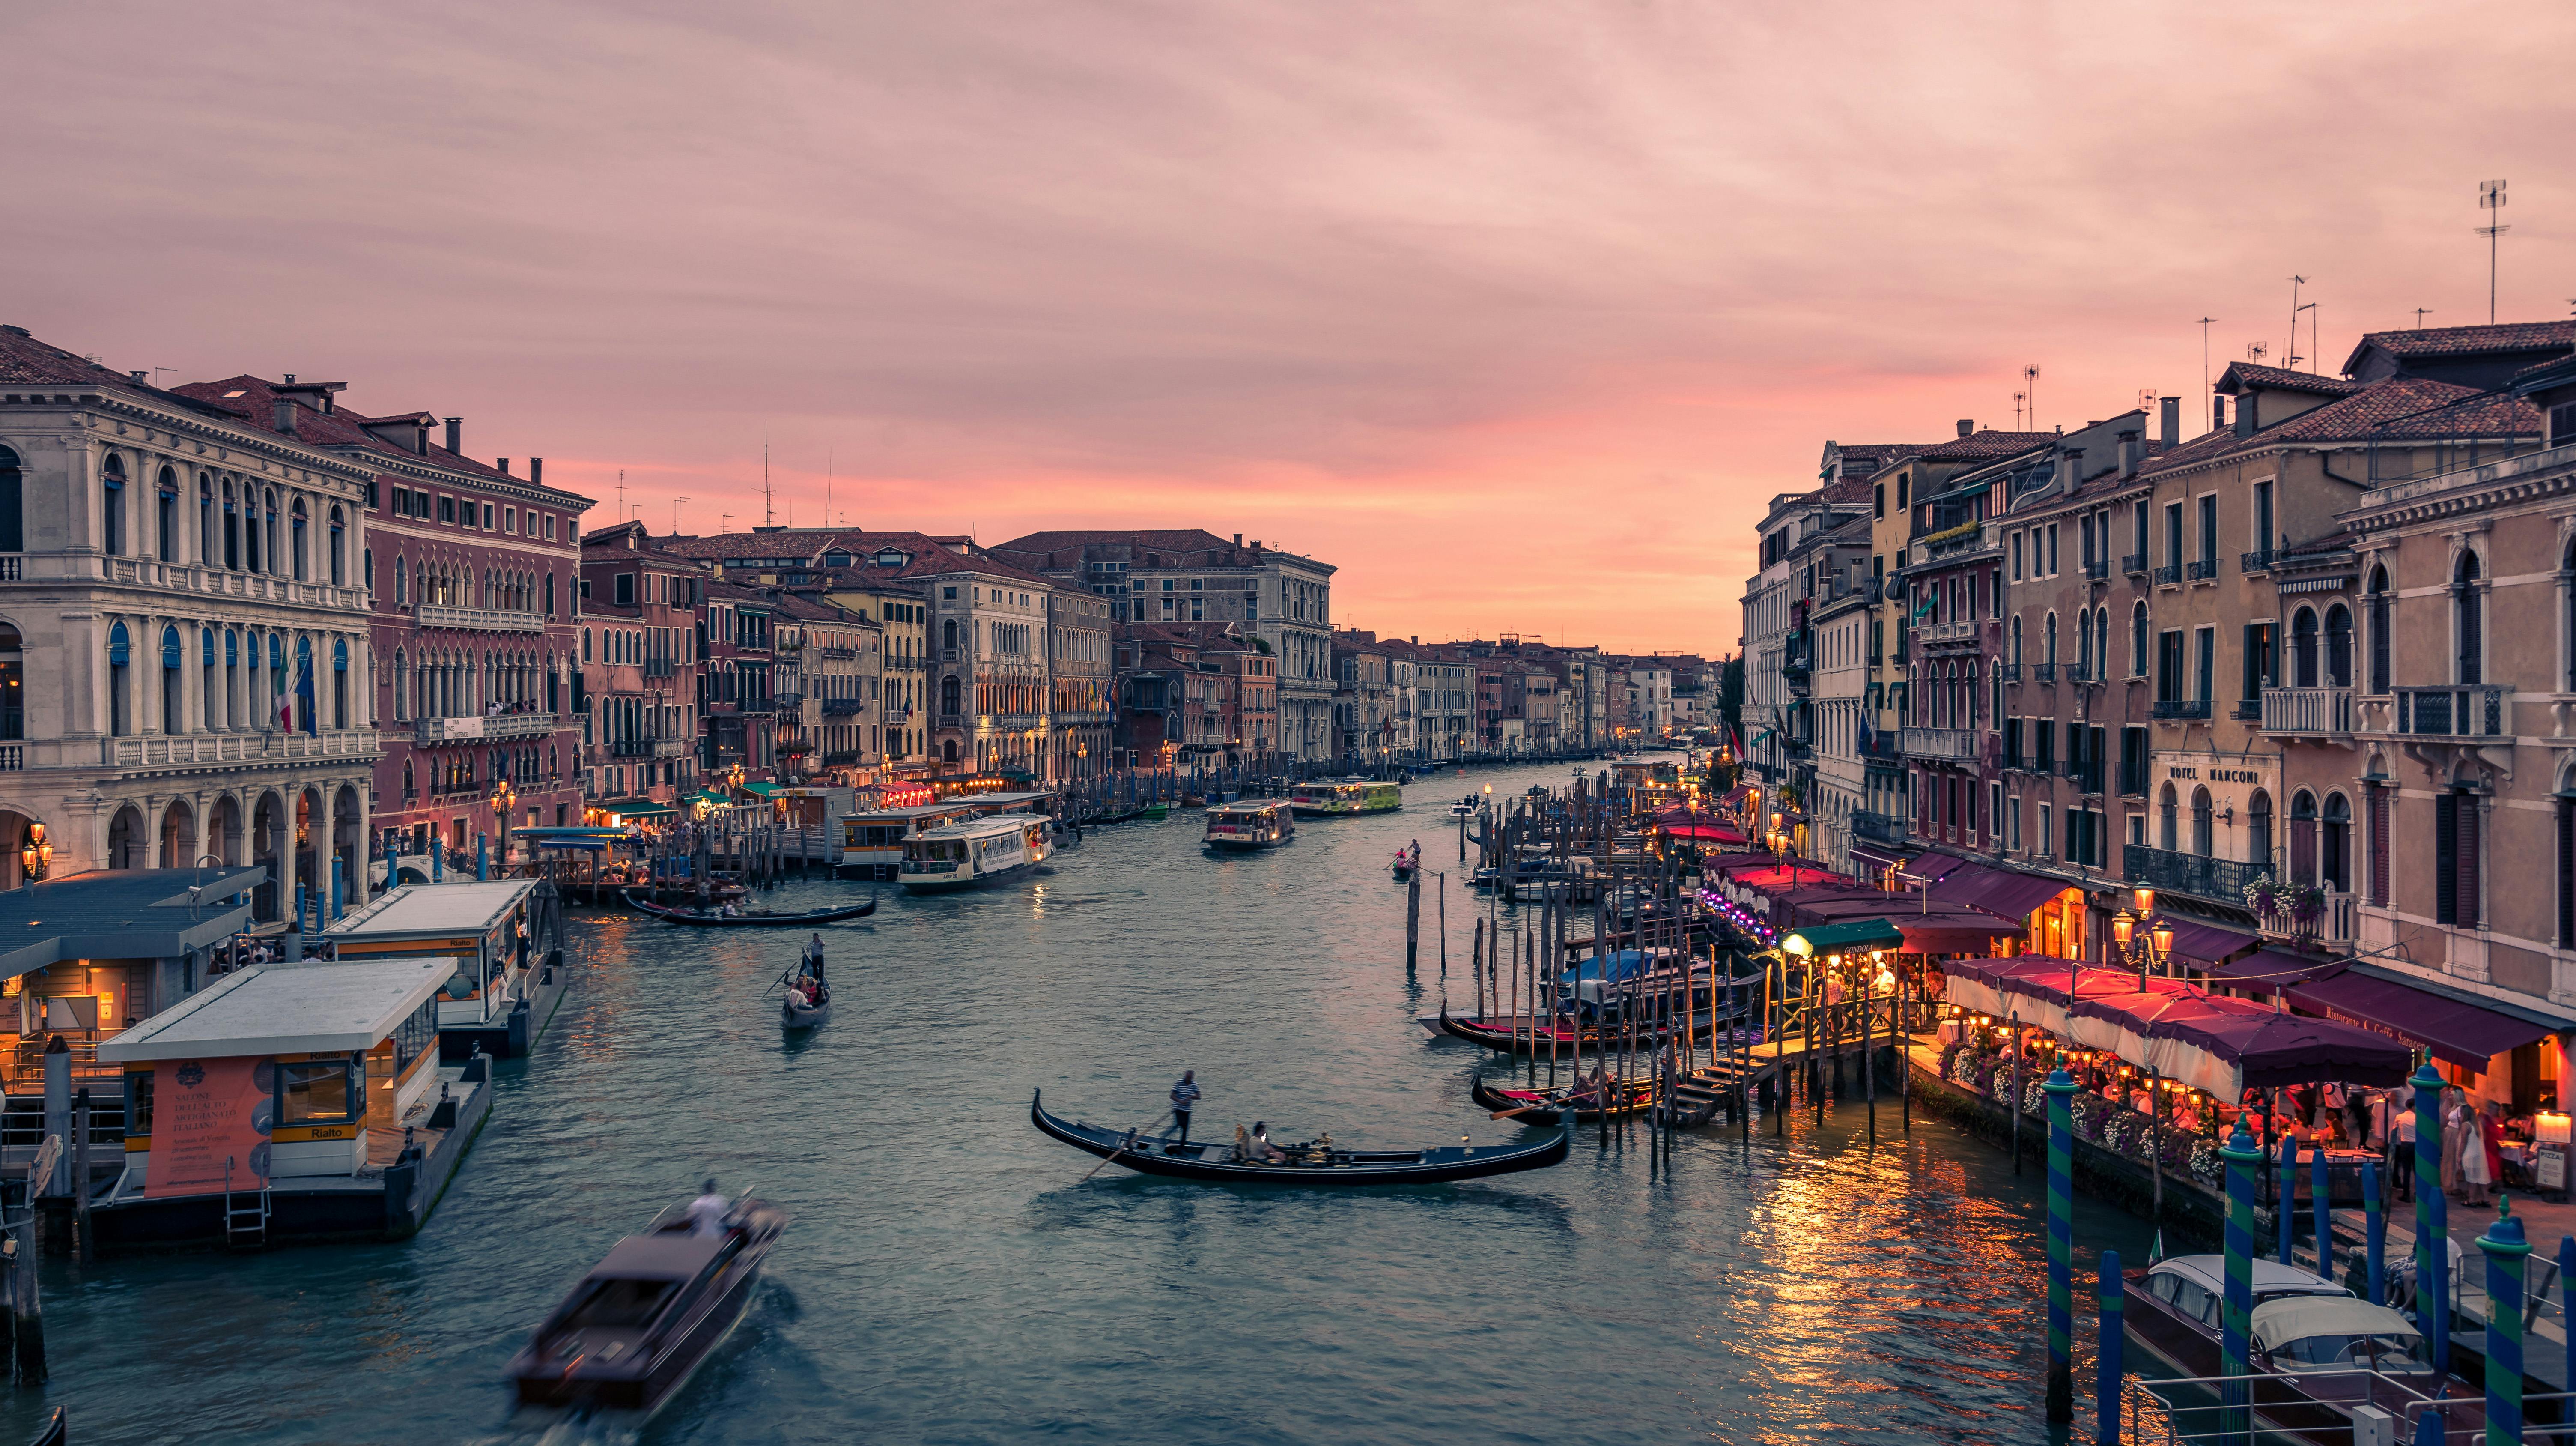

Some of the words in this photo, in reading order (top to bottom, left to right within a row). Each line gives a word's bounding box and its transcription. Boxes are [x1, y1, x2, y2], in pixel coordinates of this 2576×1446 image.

[2170, 767, 2199, 780] HOTEL
[2209, 768, 2258, 785] MARCONI
[1845, 944, 1872, 953] GONDOLA
[2326, 1006, 2360, 1027] Ristorante
[310, 1052, 340, 1060] Rialto
[176, 1093, 210, 1101] SALONE
[175, 1109, 236, 1121] ARTIGIANATO
[173, 1121, 217, 1132] ITALIANO
[311, 1128, 342, 1138] Rialto
